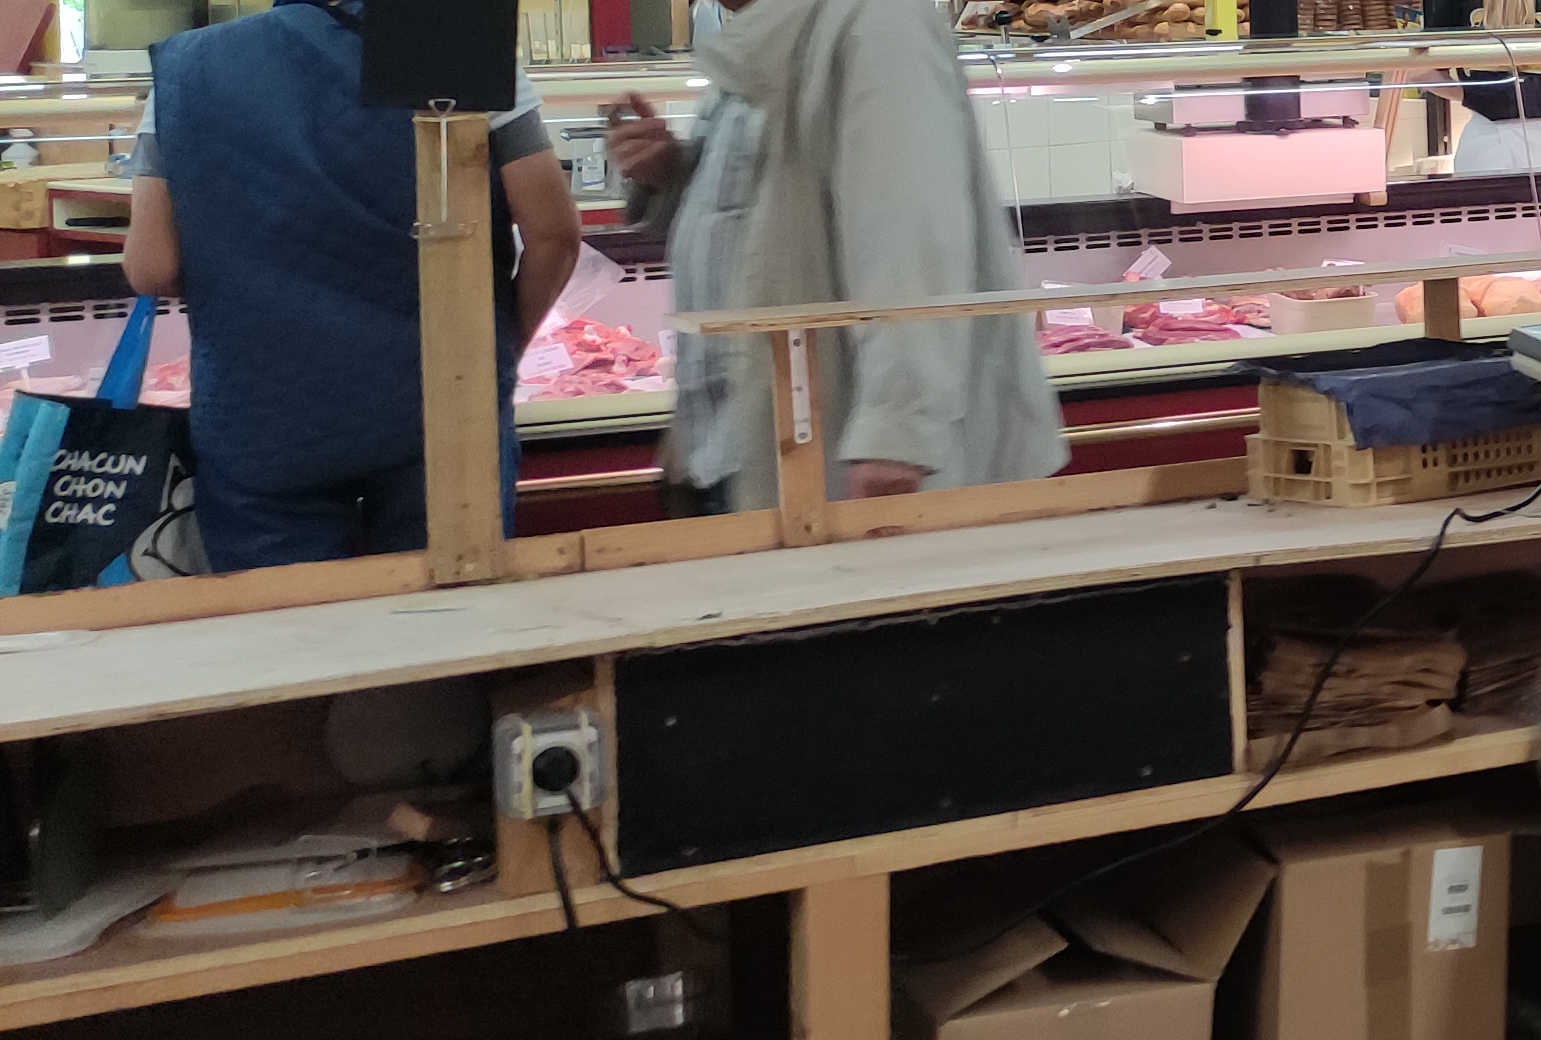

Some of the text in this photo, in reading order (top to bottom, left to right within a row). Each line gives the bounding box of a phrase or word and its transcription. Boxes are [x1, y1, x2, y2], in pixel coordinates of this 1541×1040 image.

[51, 449, 147, 476] CHACUN
[53, 474, 127, 499] CHON
[45, 501, 116, 526] CHAC
